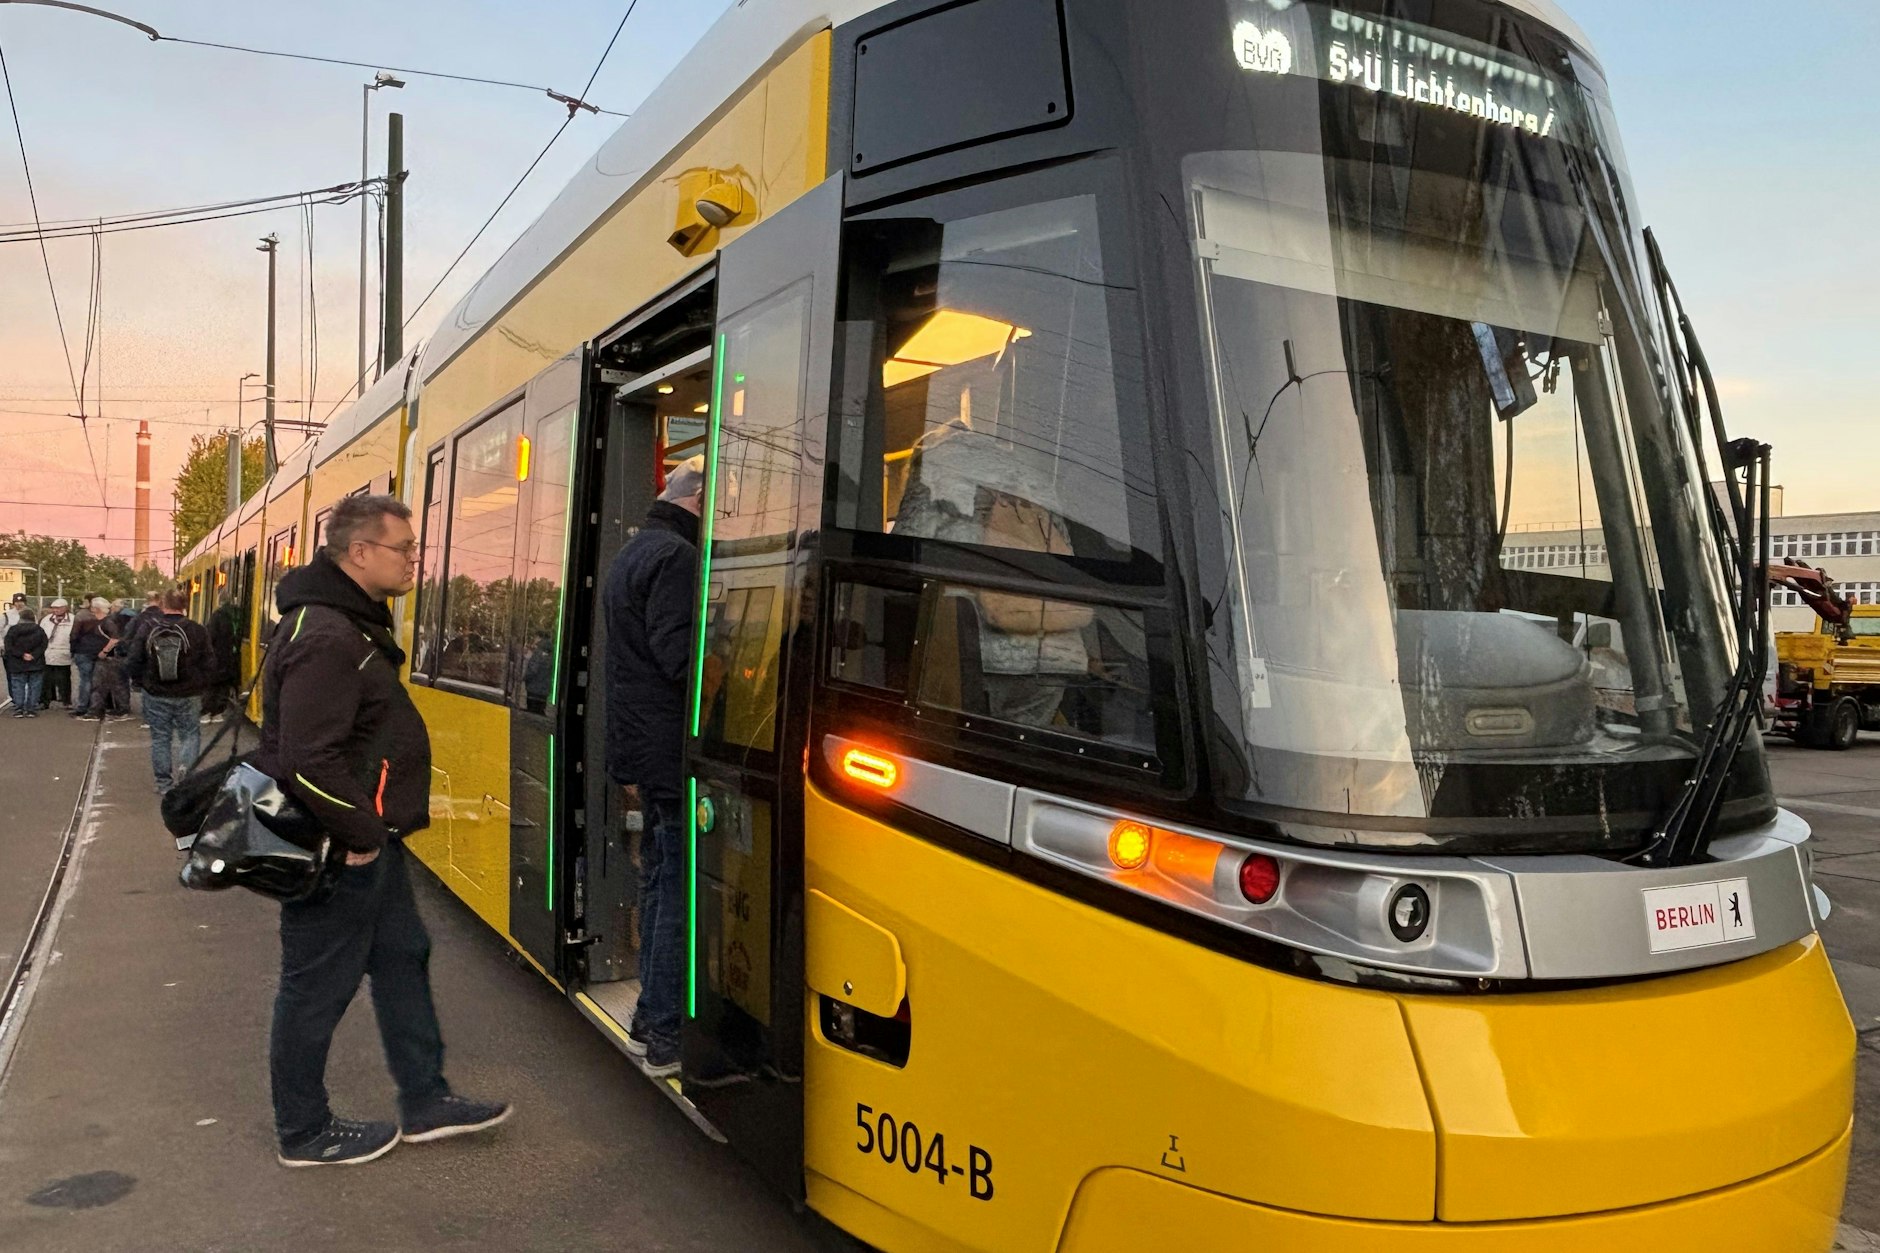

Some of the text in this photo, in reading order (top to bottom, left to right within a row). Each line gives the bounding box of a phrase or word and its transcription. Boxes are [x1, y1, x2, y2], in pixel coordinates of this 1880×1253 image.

[1329, 40, 1383, 92] S+U
[1655, 903, 1715, 931] BERLIN
[856, 1102, 995, 1201] 5004-B
